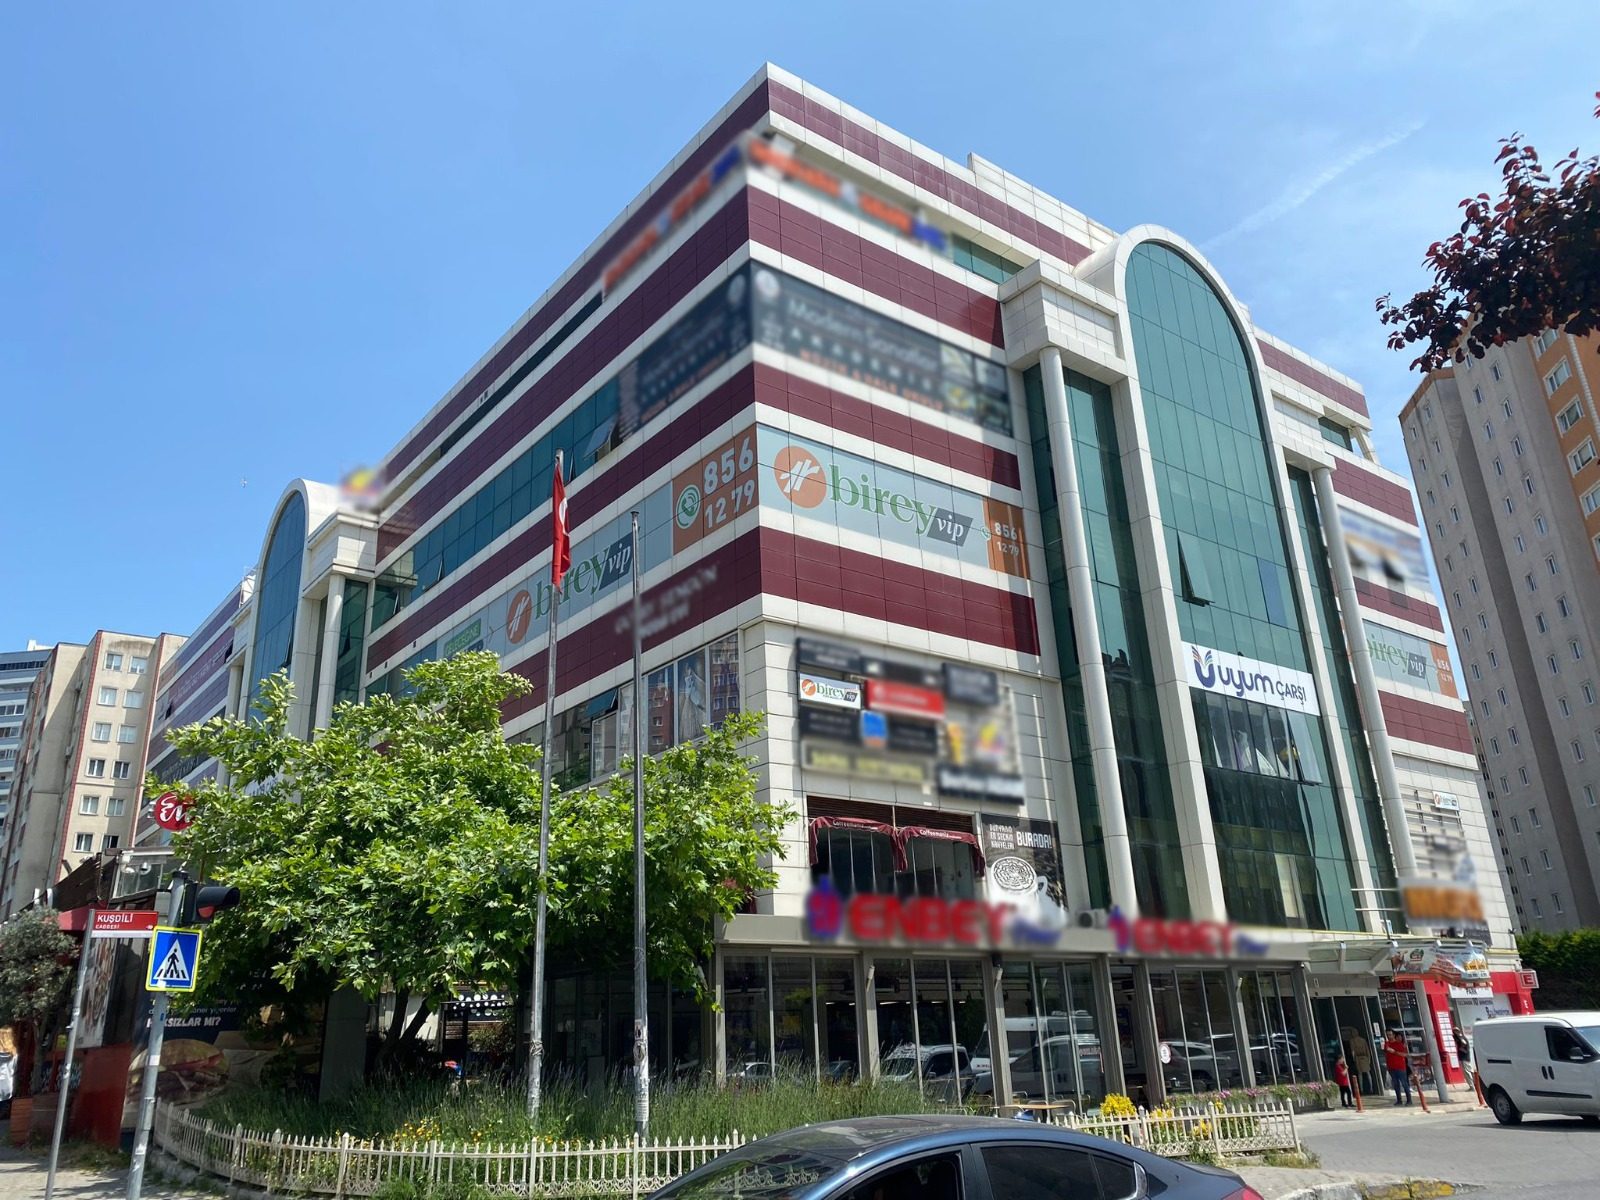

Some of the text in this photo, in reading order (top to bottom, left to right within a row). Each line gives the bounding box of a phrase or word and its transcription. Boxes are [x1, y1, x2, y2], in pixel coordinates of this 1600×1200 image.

[702, 435, 756, 496] 856
[829, 463, 965, 543] birey vip
[993, 521, 1018, 541] 856
[535, 547, 610, 620] brey
[607, 542, 632, 574] vip
[1409, 655, 1425, 677] vip
[816, 682, 846, 700] birey
[1218, 664, 1308, 706] uyum ÇARŞI
[1015, 830, 1053, 849] BURADA!
[97, 912, 134, 924] KUŞDİLİ
